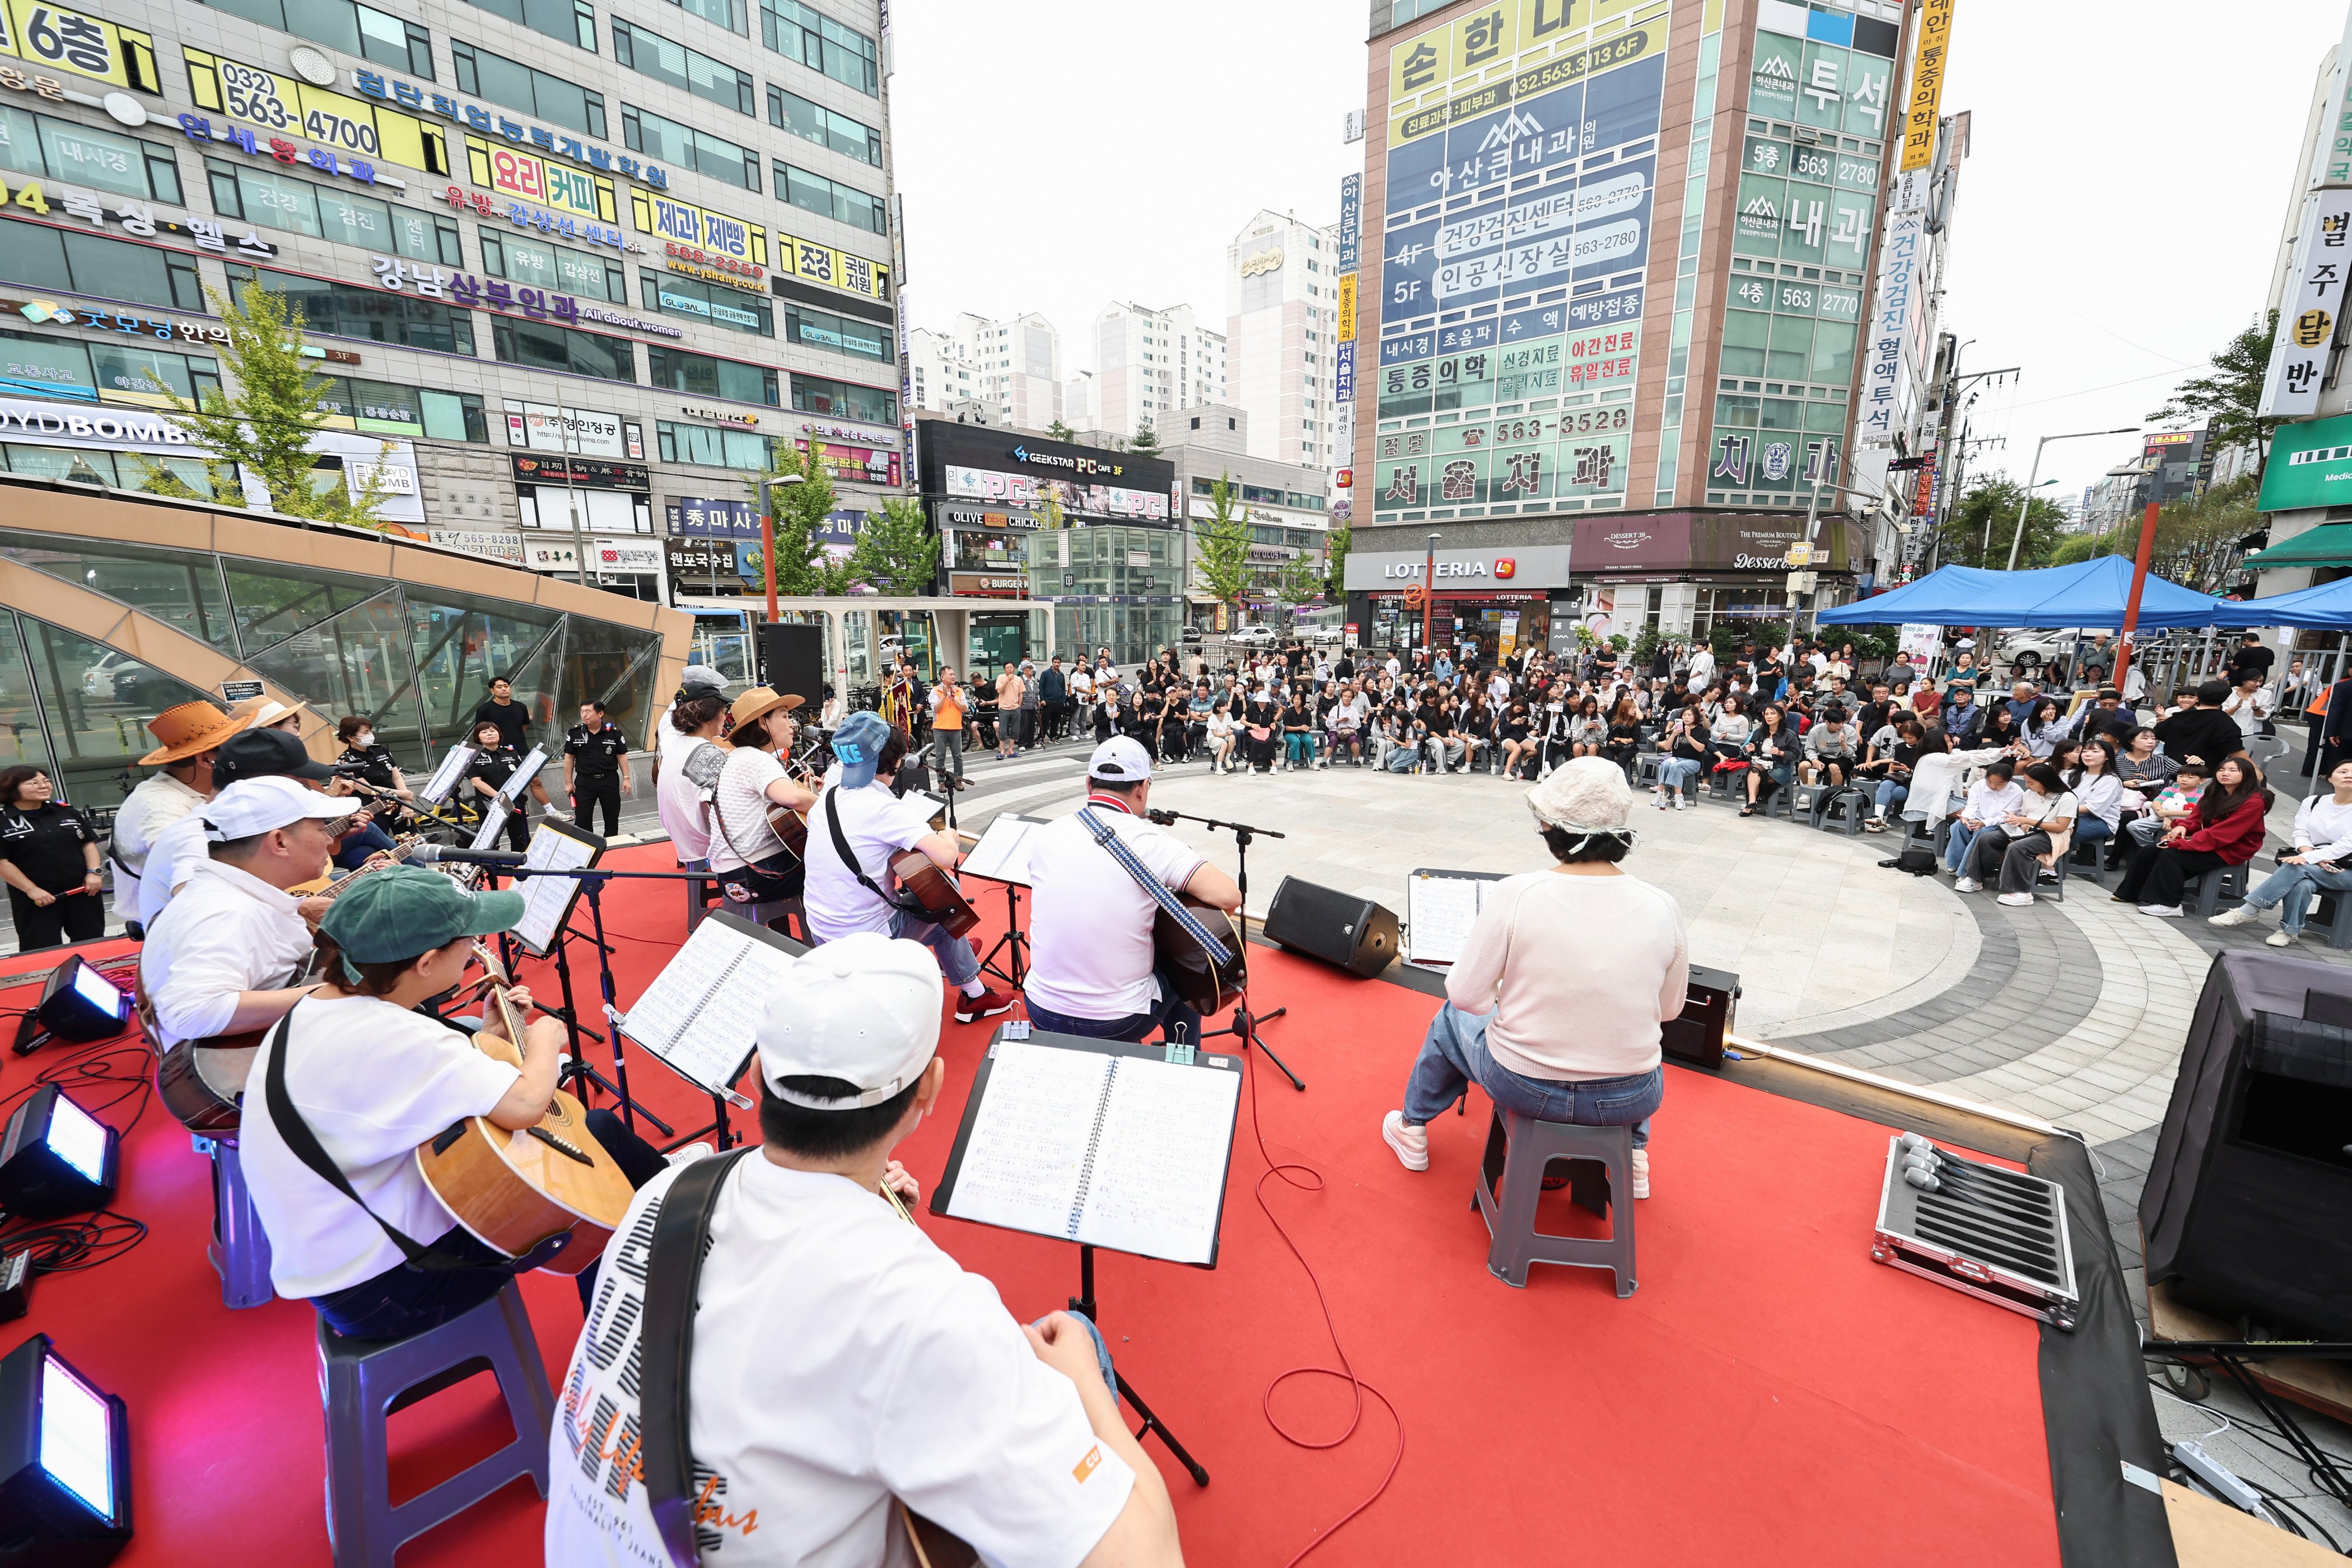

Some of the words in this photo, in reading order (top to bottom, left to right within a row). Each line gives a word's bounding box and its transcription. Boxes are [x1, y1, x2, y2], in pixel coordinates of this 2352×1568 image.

[28, 7, 110, 73] 6층
[1923, 35, 1943, 45] 마취
[222, 62, 275, 96] 032)
[1408, 106, 1452, 133] 진료과목
[1459, 90, 1496, 113] 피부과
[1615, 40, 1639, 59] 6F
[1755, 75, 1795, 92] 아산큰내과
[1804, 59, 1888, 130] 투석
[1908, 46, 1943, 148] 통증의학과
[227, 86, 378, 155] 563-4700
[60, 141, 127, 172] 내시경
[1429, 127, 1576, 190] 아산큰내과
[1582, 119, 1597, 150] 의원
[1753, 146, 1780, 169] 5층
[1798, 154, 1828, 177] 563
[1838, 161, 1876, 186] 2780
[1909, 152, 1924, 160] 의원
[493, 151, 544, 199] 요리
[549, 166, 595, 216] 커피
[260, 189, 298, 213] 건강
[339, 206, 375, 231] 검진
[407, 218, 425, 251] 센터
[655, 199, 699, 244] 제과
[705, 214, 746, 258] 제빵
[1341, 185, 1358, 261] 아산큰내과
[1444, 193, 1574, 253] 건강검진센터
[1578, 184, 1640, 212] 563-2770
[1740, 214, 1779, 230] 아산큰내과
[1790, 198, 1872, 254] 내과
[628, 242, 641, 254] 5F
[665, 242, 764, 279] 568-2259
[799, 244, 832, 281] 조경
[1395, 242, 1424, 266] 4F
[1441, 239, 1572, 293] 인공신장실
[1574, 231, 1636, 258] 563-2780
[516, 250, 544, 270] 유방
[564, 260, 601, 284] 갑상선
[667, 259, 768, 293] www.yshang.co.kr
[845, 256, 871, 274] 국비
[1339, 274, 1356, 283] 미래안
[372, 255, 580, 325] 강남산부인과
[846, 274, 872, 295] 지원
[1394, 281, 1421, 304] 5F
[1738, 282, 1765, 304] 4층
[1782, 288, 1812, 309] 563
[1822, 294, 1859, 315] 2770
[1881, 233, 1915, 333] 건강검진
[585, 307, 602, 323] All
[603, 312, 640, 332] about
[641, 320, 683, 338] women
[1341, 287, 1351, 339] 통증의학과
[1570, 294, 1640, 321] 예방접종
[335, 352, 350, 361] 3F
[1386, 334, 1429, 357] 내시경
[1443, 325, 1492, 348] 초음파
[1572, 332, 1634, 357] 야간진료
[7, 363, 76, 381] 교통사고
[1109, 358, 1119, 367] 105
[1503, 344, 1559, 370] 신경치료
[1570, 358, 1631, 383] 휴일진료
[1338, 349, 1351, 401] 서울치과
[1386, 354, 1487, 394] 통증의학
[1867, 338, 1900, 431] 혈액투석
[366, 407, 410, 422] 통증순환
[904, 396, 911, 405] 4F
[745, 413, 758, 424] 3F
[1338, 405, 1347, 435] 미래안
[1496, 408, 1628, 443] 563-3528
[1862, 434, 1890, 444] 563-2770
[1029, 452, 1074, 469] GEEKSTAR
[1075, 456, 1097, 475] PC
[1098, 464, 1111, 473] CAFE
[1113, 465, 1122, 476] 3F
[1385, 444, 1615, 505] 서울치과
[982, 472, 1028, 506] PC
[954, 511, 983, 524] OLIVE
[1128, 491, 1160, 520] PC
[464, 533, 519, 545] 565-8298
[992, 579, 1023, 589] BURGER
[1385, 561, 1487, 578] LOTTERIA
[1086, 1449, 1101, 1467] CU
